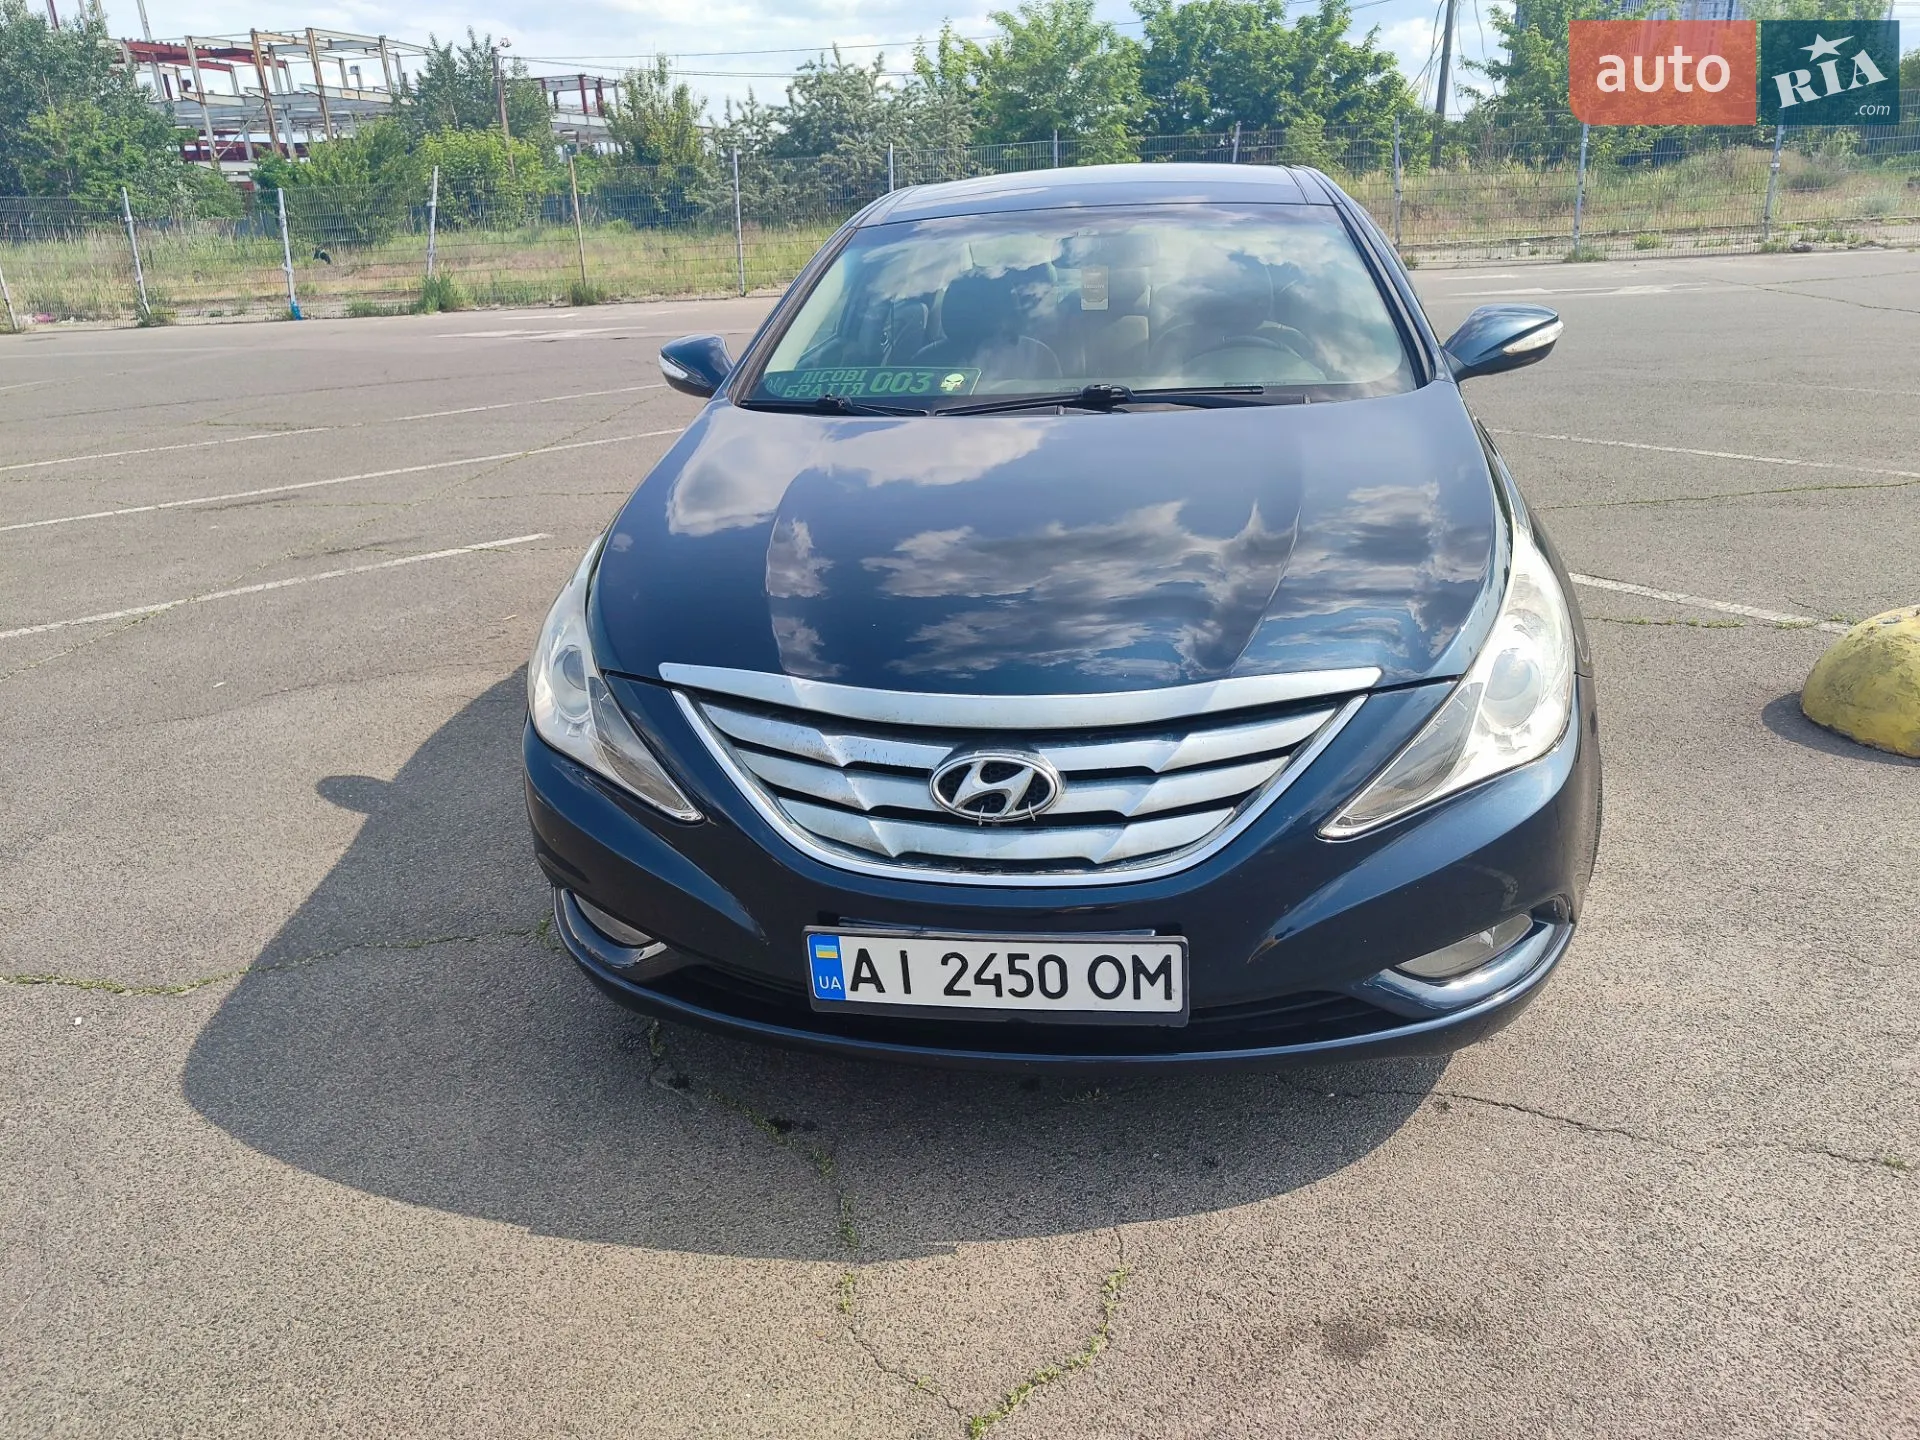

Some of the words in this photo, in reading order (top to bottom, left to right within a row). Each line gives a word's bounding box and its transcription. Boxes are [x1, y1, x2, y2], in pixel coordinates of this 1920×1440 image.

[869, 372, 934, 394] 003
[819, 975, 842, 991] UA
[940, 951, 1069, 1000] 2450
[1087, 954, 1173, 1001] OM
